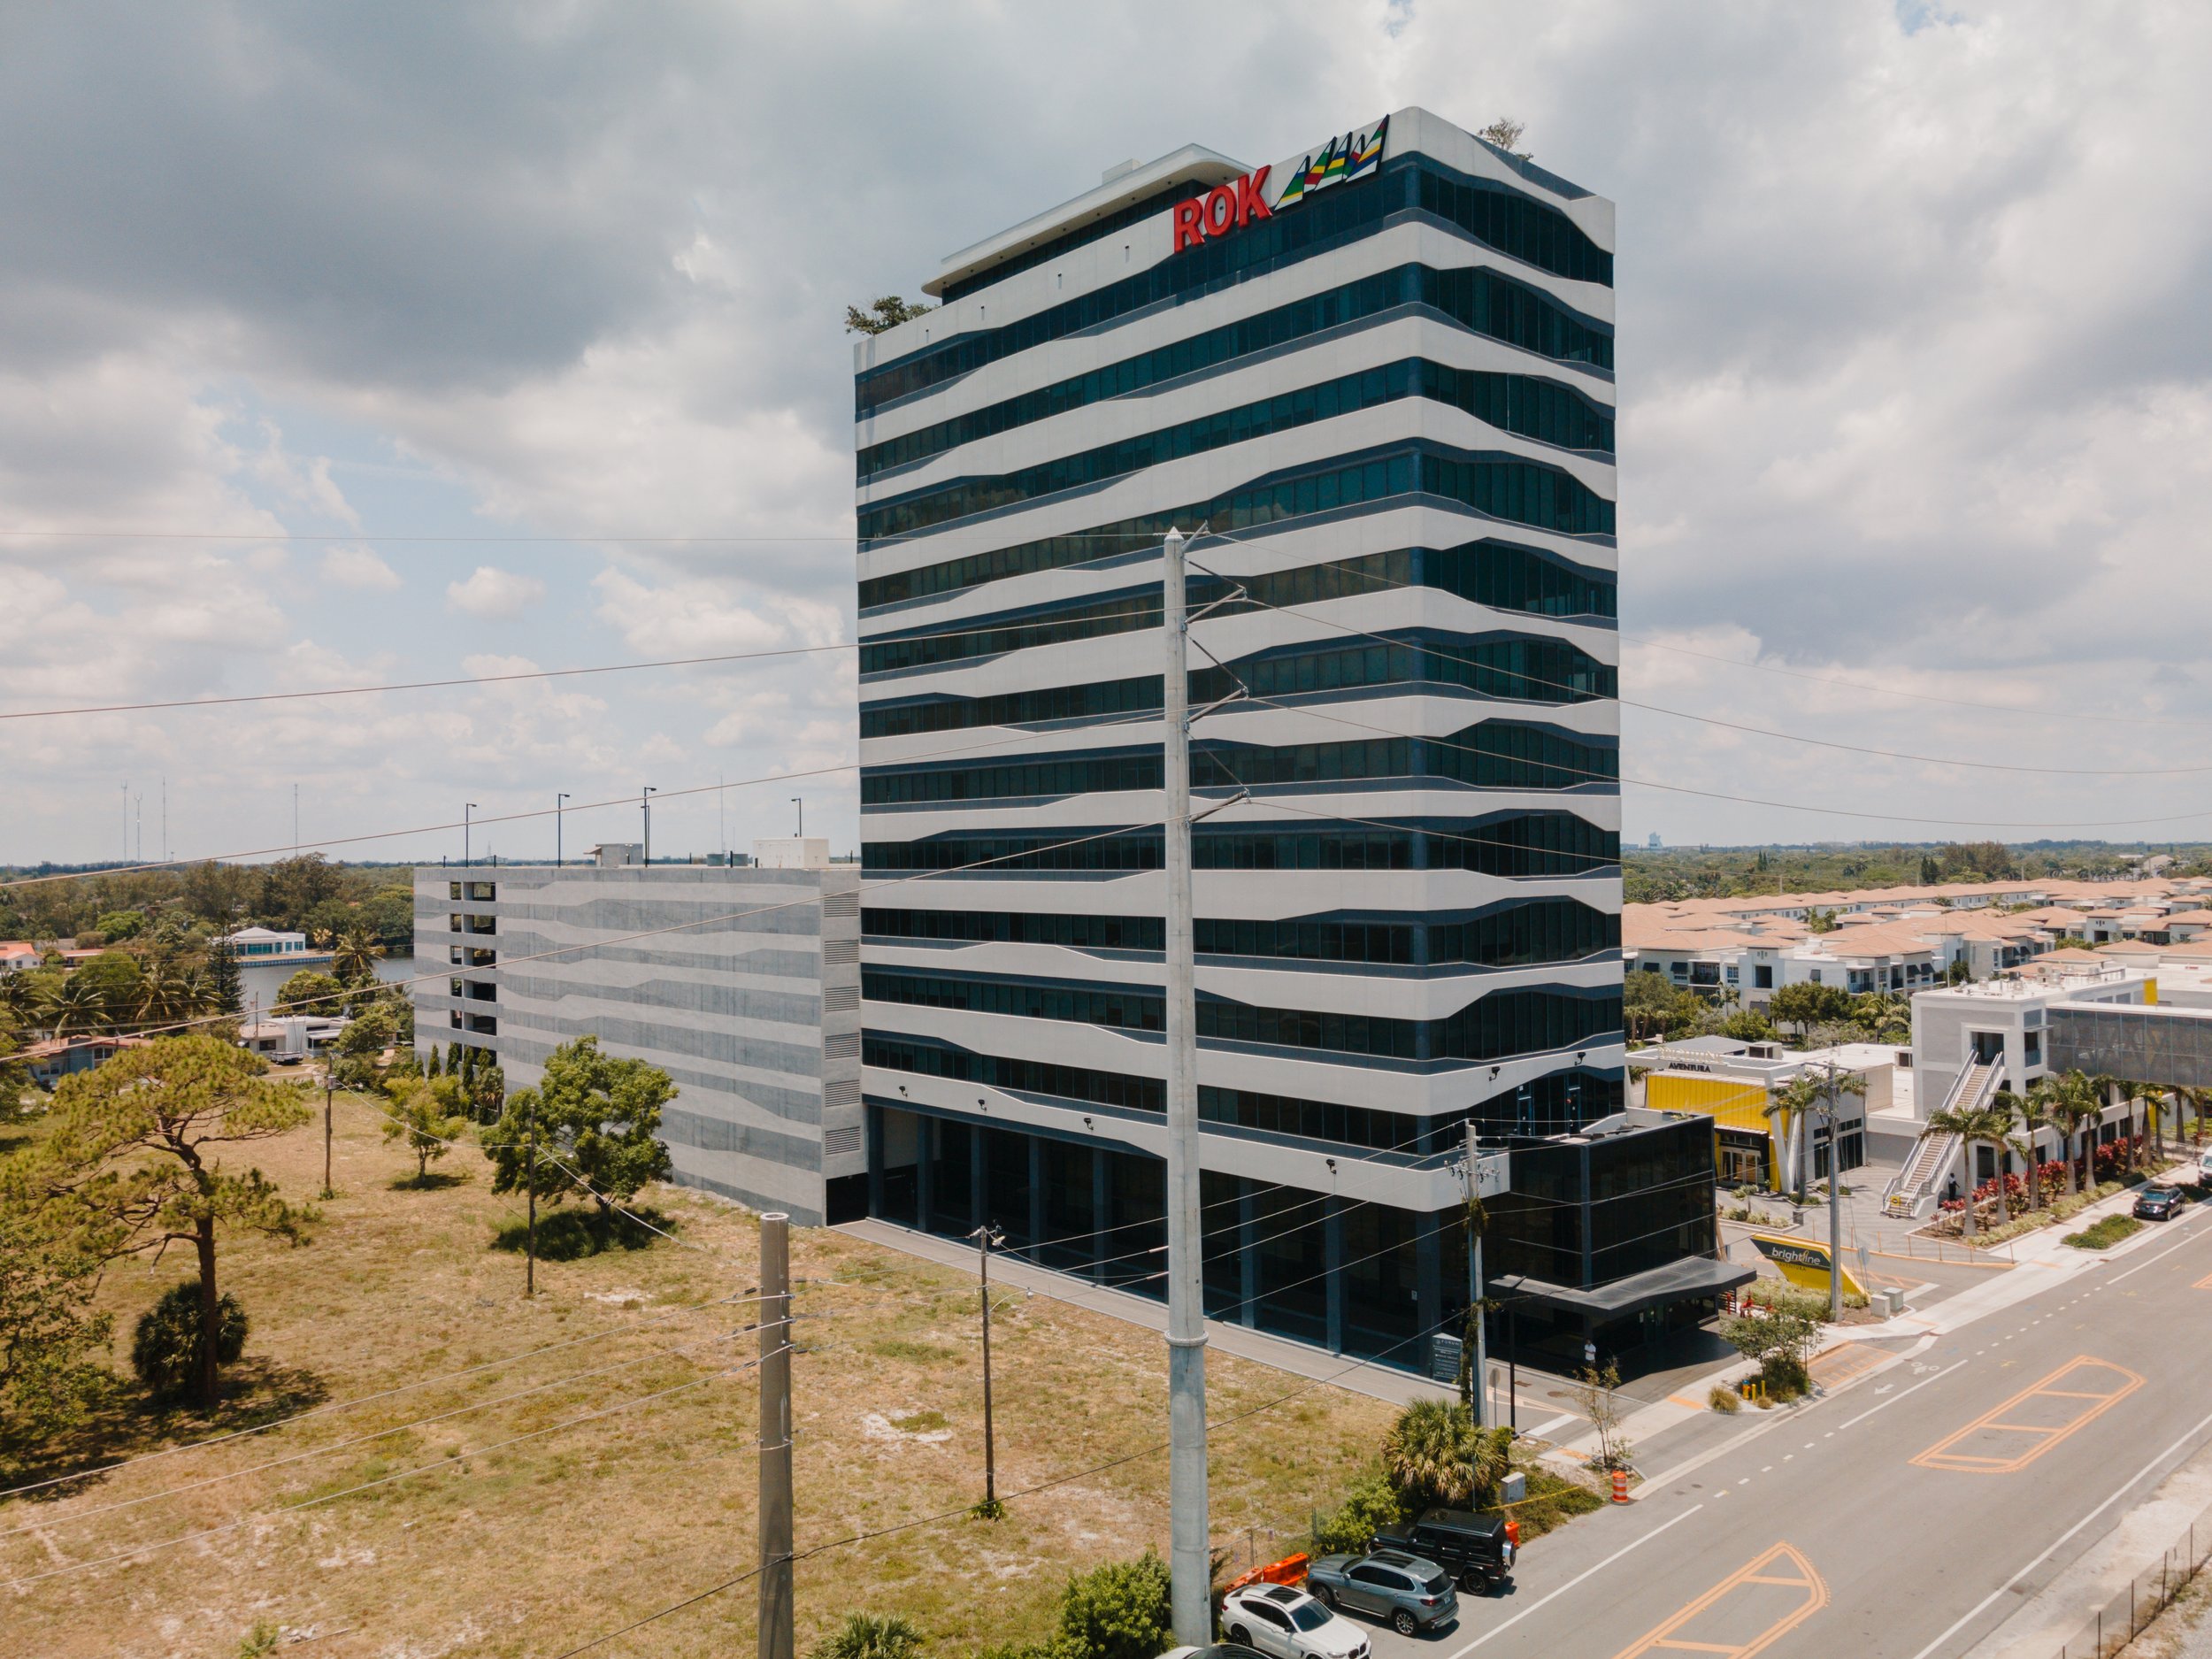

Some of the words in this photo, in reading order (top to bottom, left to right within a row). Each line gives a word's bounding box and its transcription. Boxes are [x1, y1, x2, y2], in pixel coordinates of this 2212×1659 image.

[1173, 165, 1273, 254] ROK
[1669, 1062, 1711, 1072] AVENTURA
[1772, 1247, 1821, 1265] brightline
